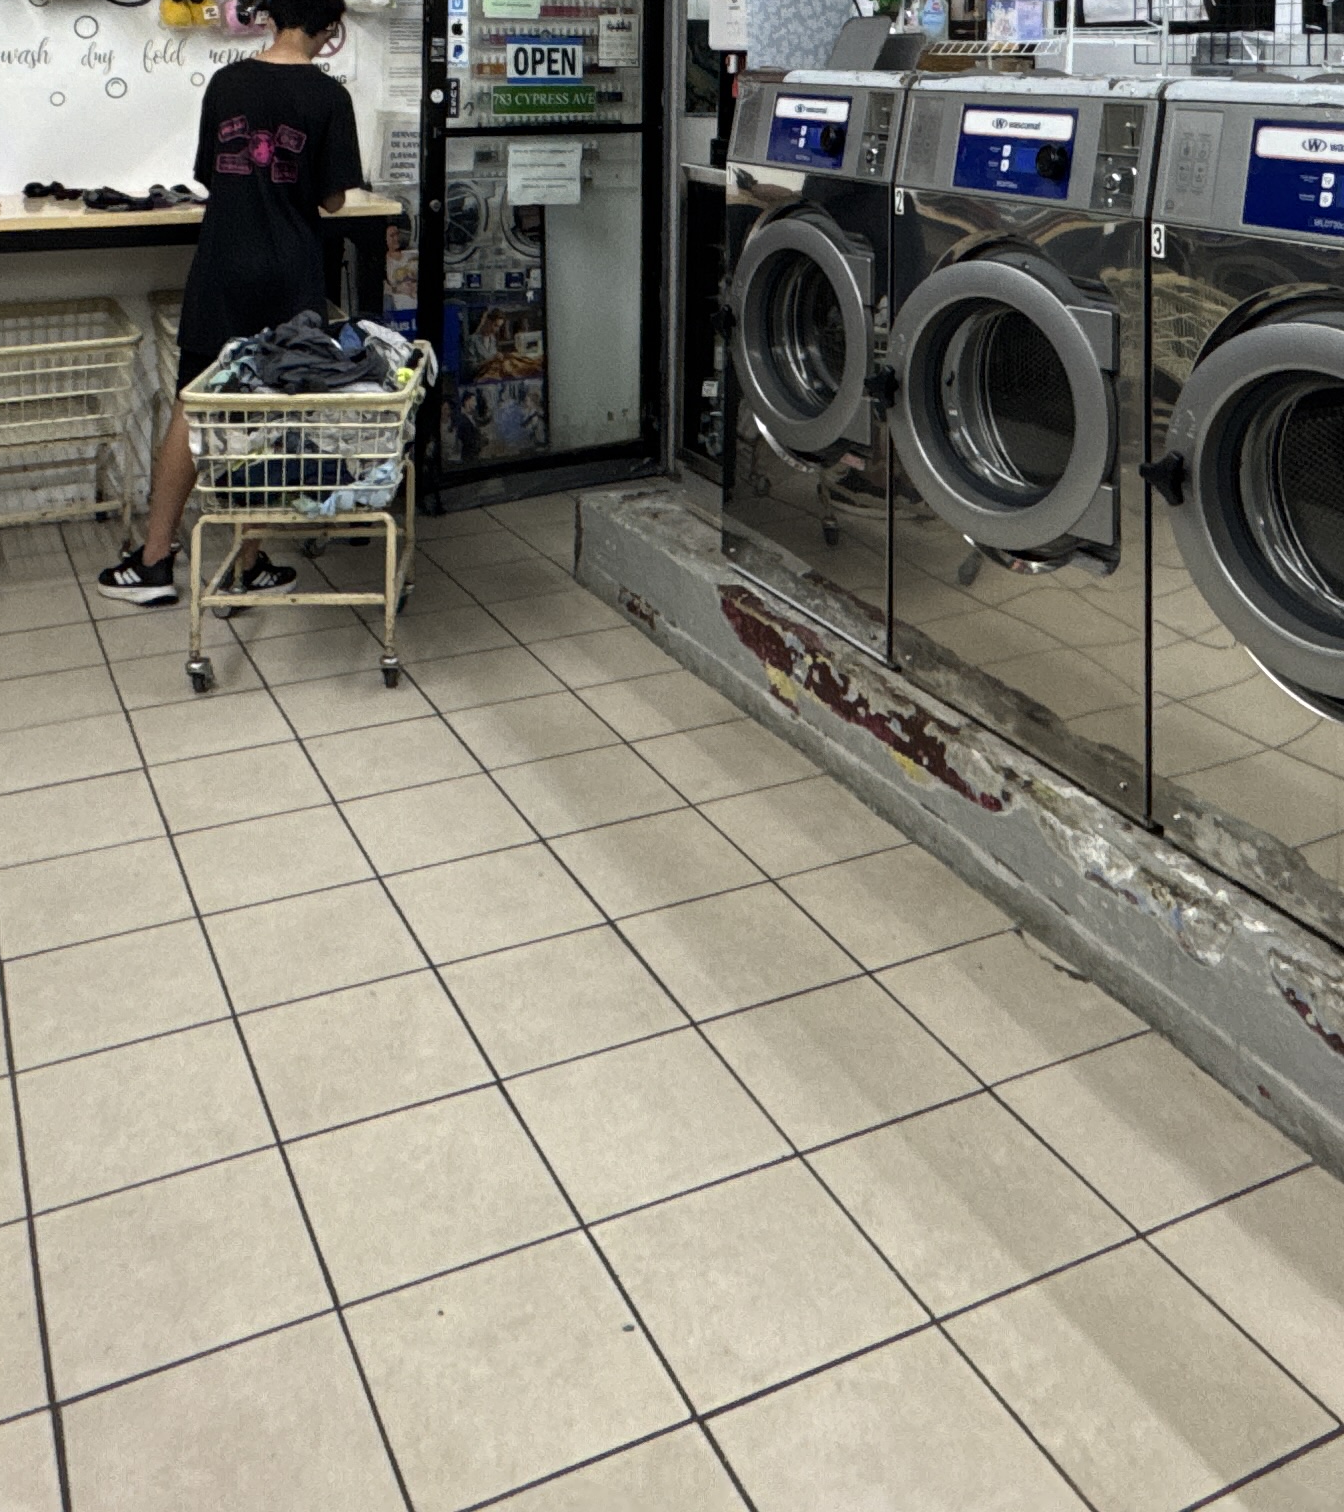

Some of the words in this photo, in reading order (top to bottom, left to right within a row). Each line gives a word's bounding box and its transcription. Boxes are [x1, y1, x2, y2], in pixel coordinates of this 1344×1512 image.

[0, 36, 52, 68] wash
[80, 37, 116, 74] dry
[142, 38, 187, 73] fold
[513, 46, 577, 76] OPEN
[494, 93, 512, 105] 783
[514, 93, 570, 105] CYPRESS
[571, 93, 595, 105] AVE
[895, 191, 903, 212] 2
[1153, 226, 1163, 256] 3
